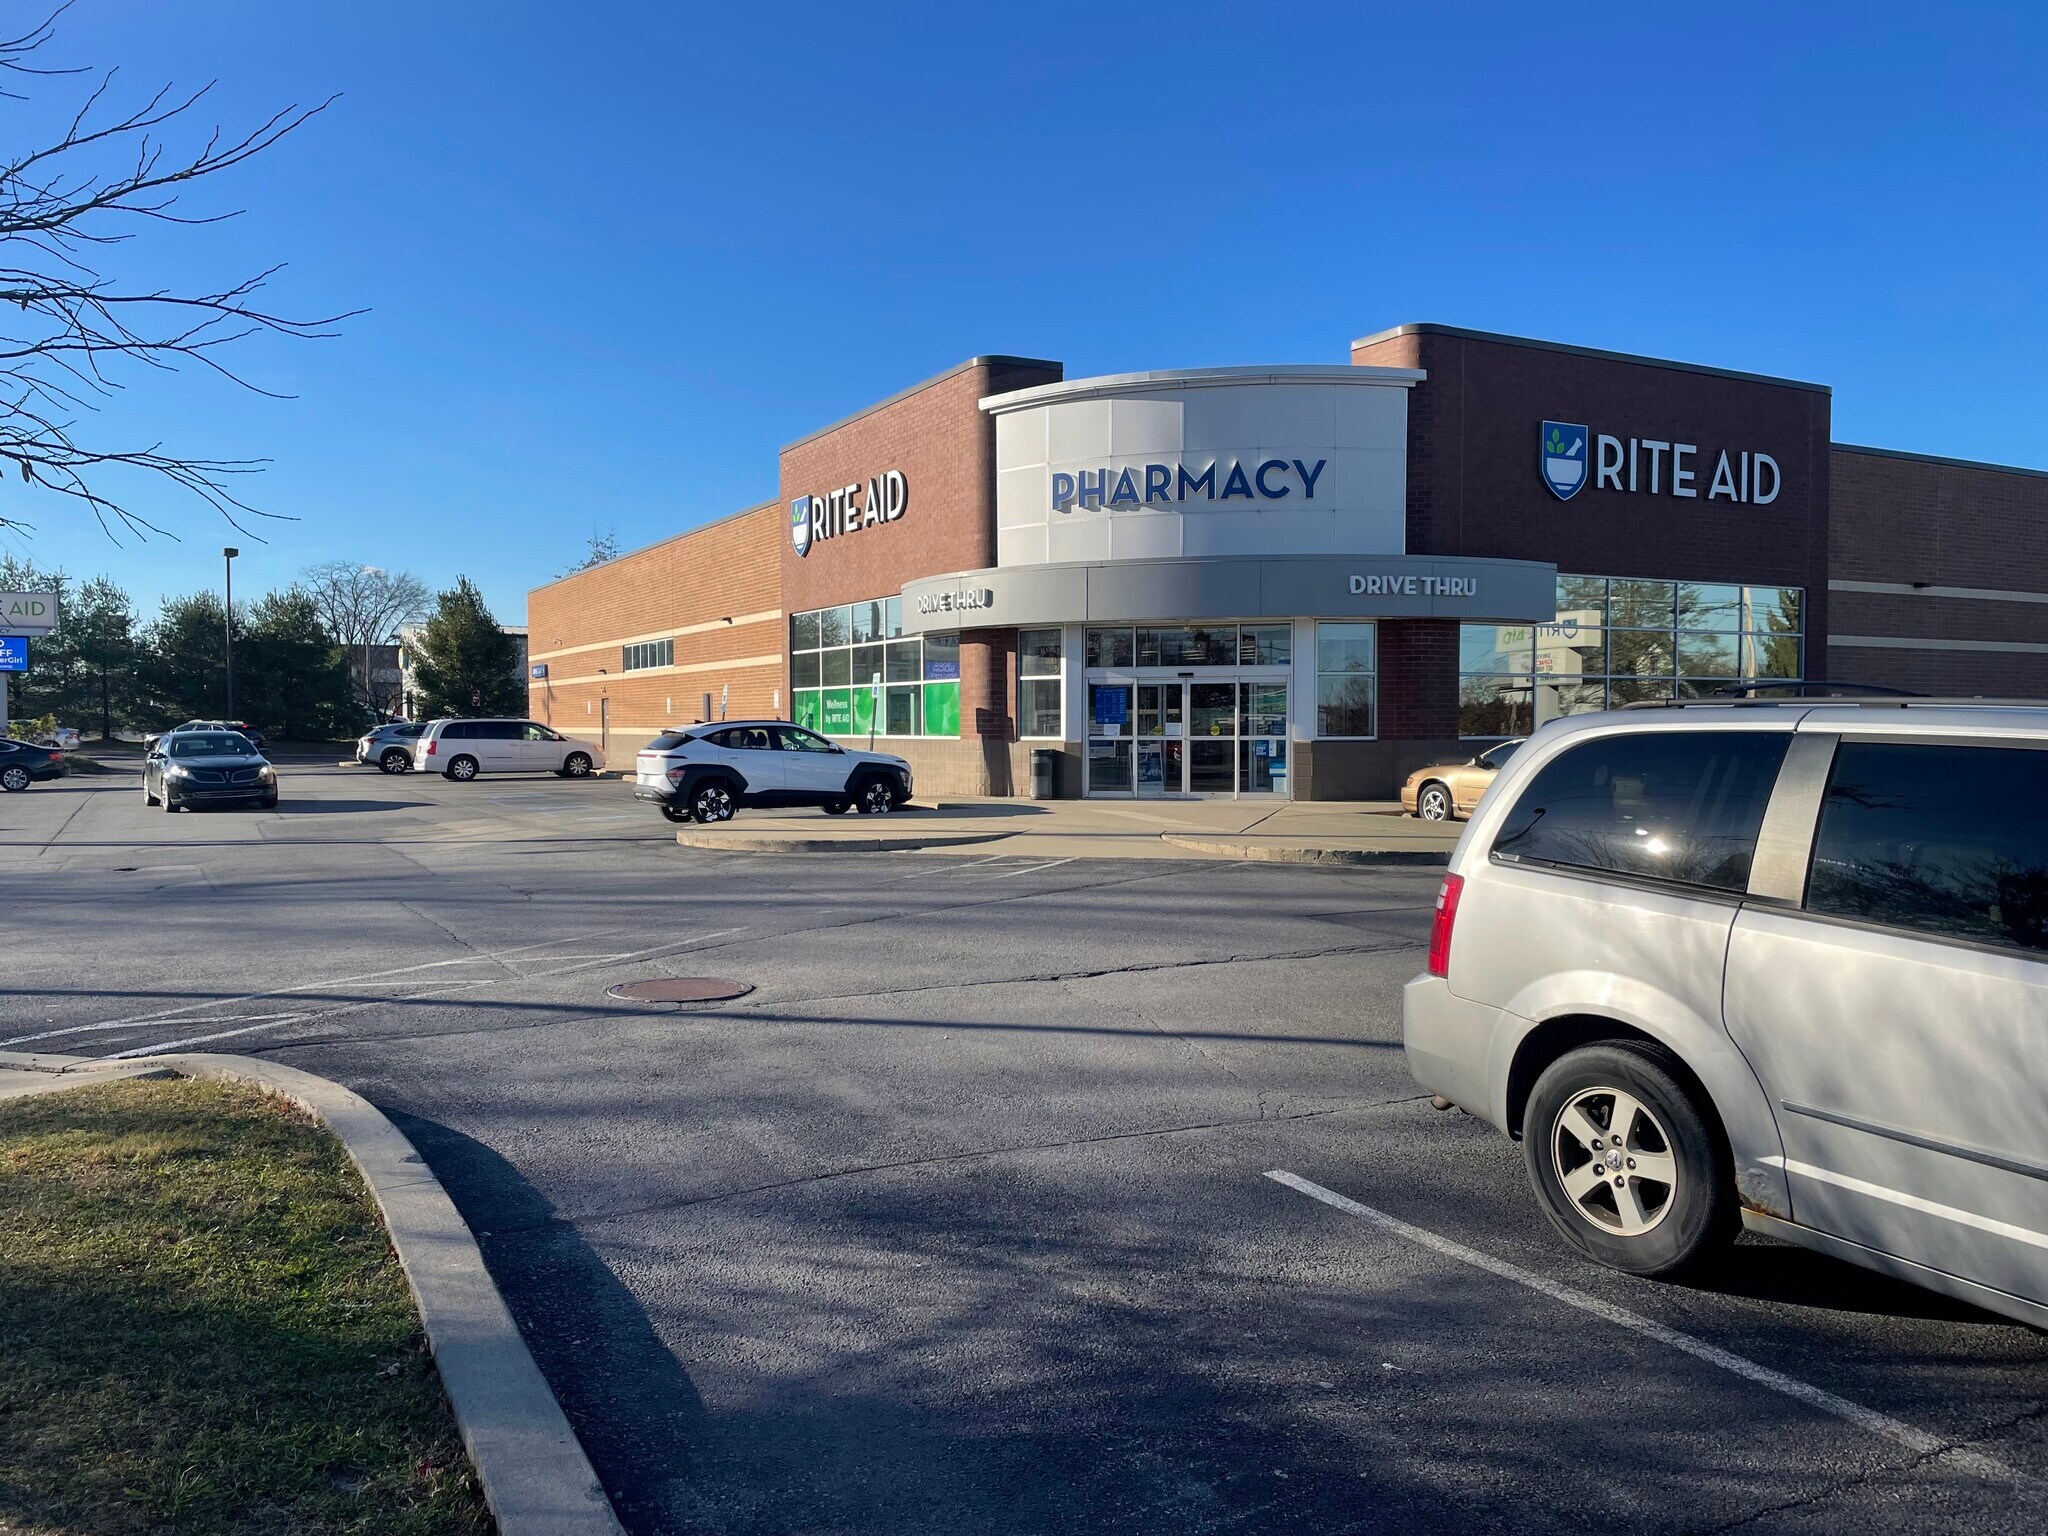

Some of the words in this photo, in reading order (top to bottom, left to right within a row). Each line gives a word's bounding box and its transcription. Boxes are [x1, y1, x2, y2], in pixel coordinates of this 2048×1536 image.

[1597, 433, 1697, 498] RITE
[1708, 448, 1781, 505] AID
[1052, 459, 1327, 512] PHARMACY
[812, 483, 860, 541] RITE
[863, 469, 907, 528] AID
[1350, 575, 1418, 595] DRIVE
[1420, 576, 1477, 597] THRU
[9, 601, 46, 616] AID
[917, 592, 947, 612] DRIVE
[948, 588, 989, 609] THRU
[0, 649, 13, 657] FF
[0, 656, 23, 664] erGirl
[825, 700, 848, 710] Wellness
[825, 714, 831, 725] by
[831, 713, 842, 723] RITE
